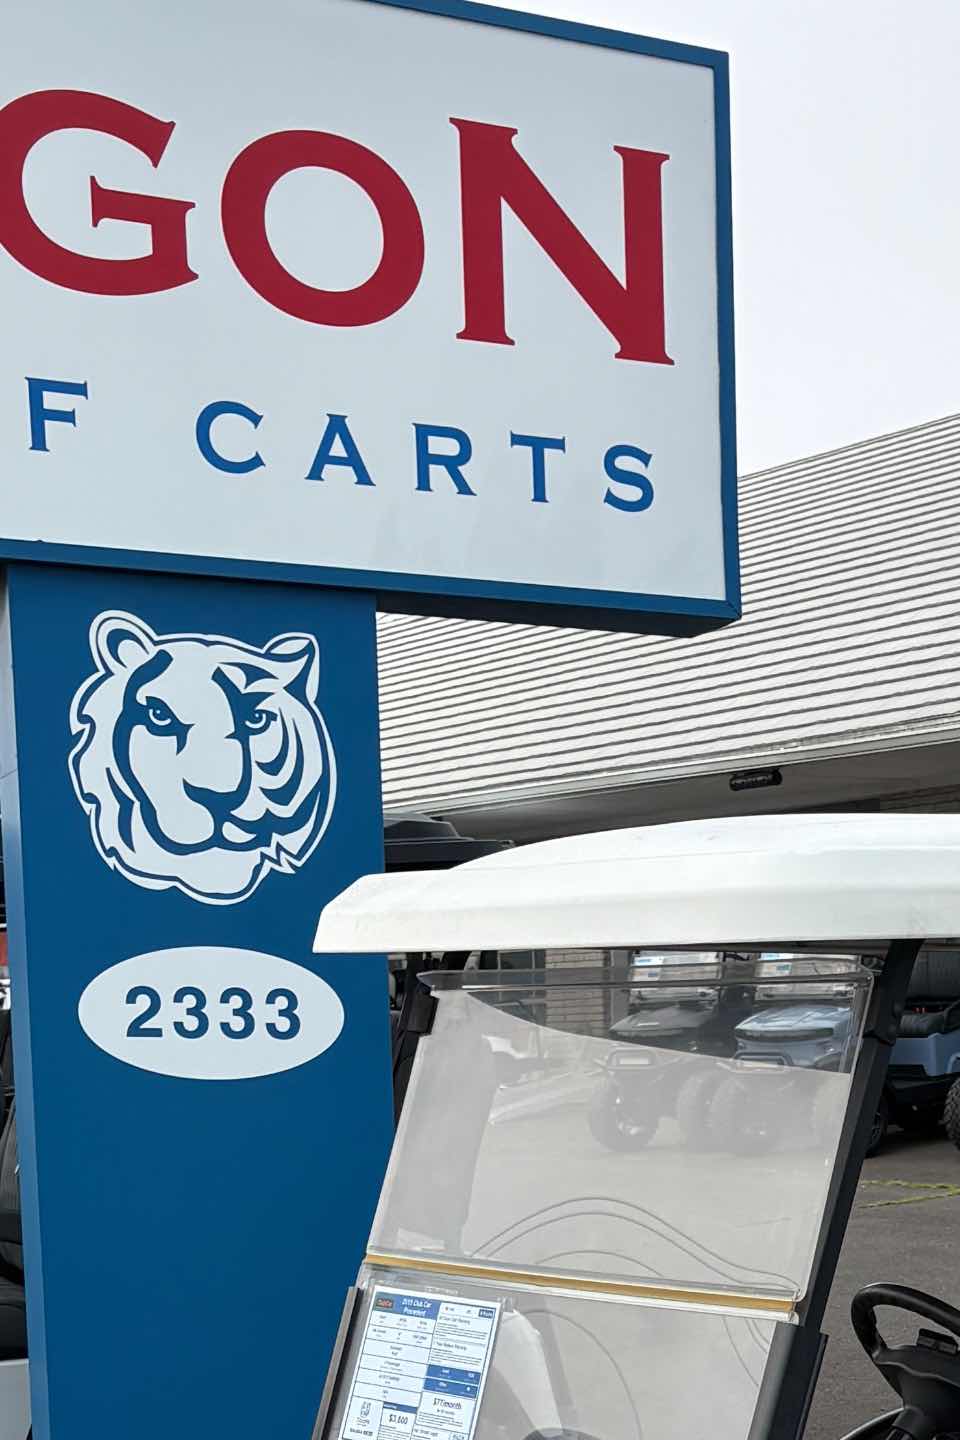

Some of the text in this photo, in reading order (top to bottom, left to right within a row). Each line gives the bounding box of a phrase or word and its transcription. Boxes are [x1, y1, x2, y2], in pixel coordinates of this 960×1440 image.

[0, 89, 674, 365] GON
[24, 376, 656, 513] F CARTS
[125, 985, 302, 1040] 2333
